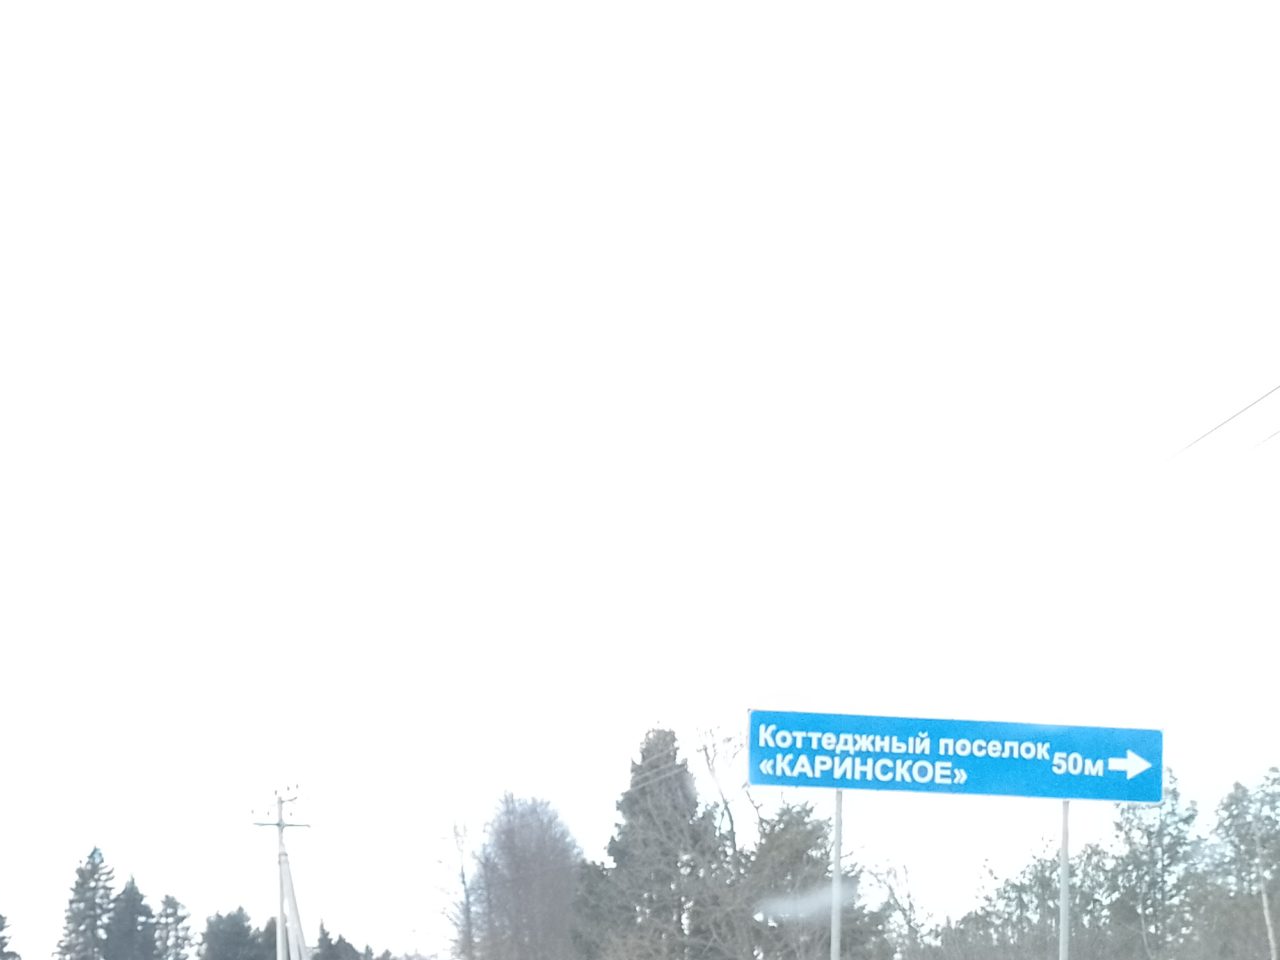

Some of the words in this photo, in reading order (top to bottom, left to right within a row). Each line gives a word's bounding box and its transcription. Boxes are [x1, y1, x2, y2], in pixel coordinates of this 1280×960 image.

[758, 724, 931, 756] Коттеджный
[938, 741, 1050, 760] поселок
[759, 754, 968, 786] «КАРИНСКОЕ»
